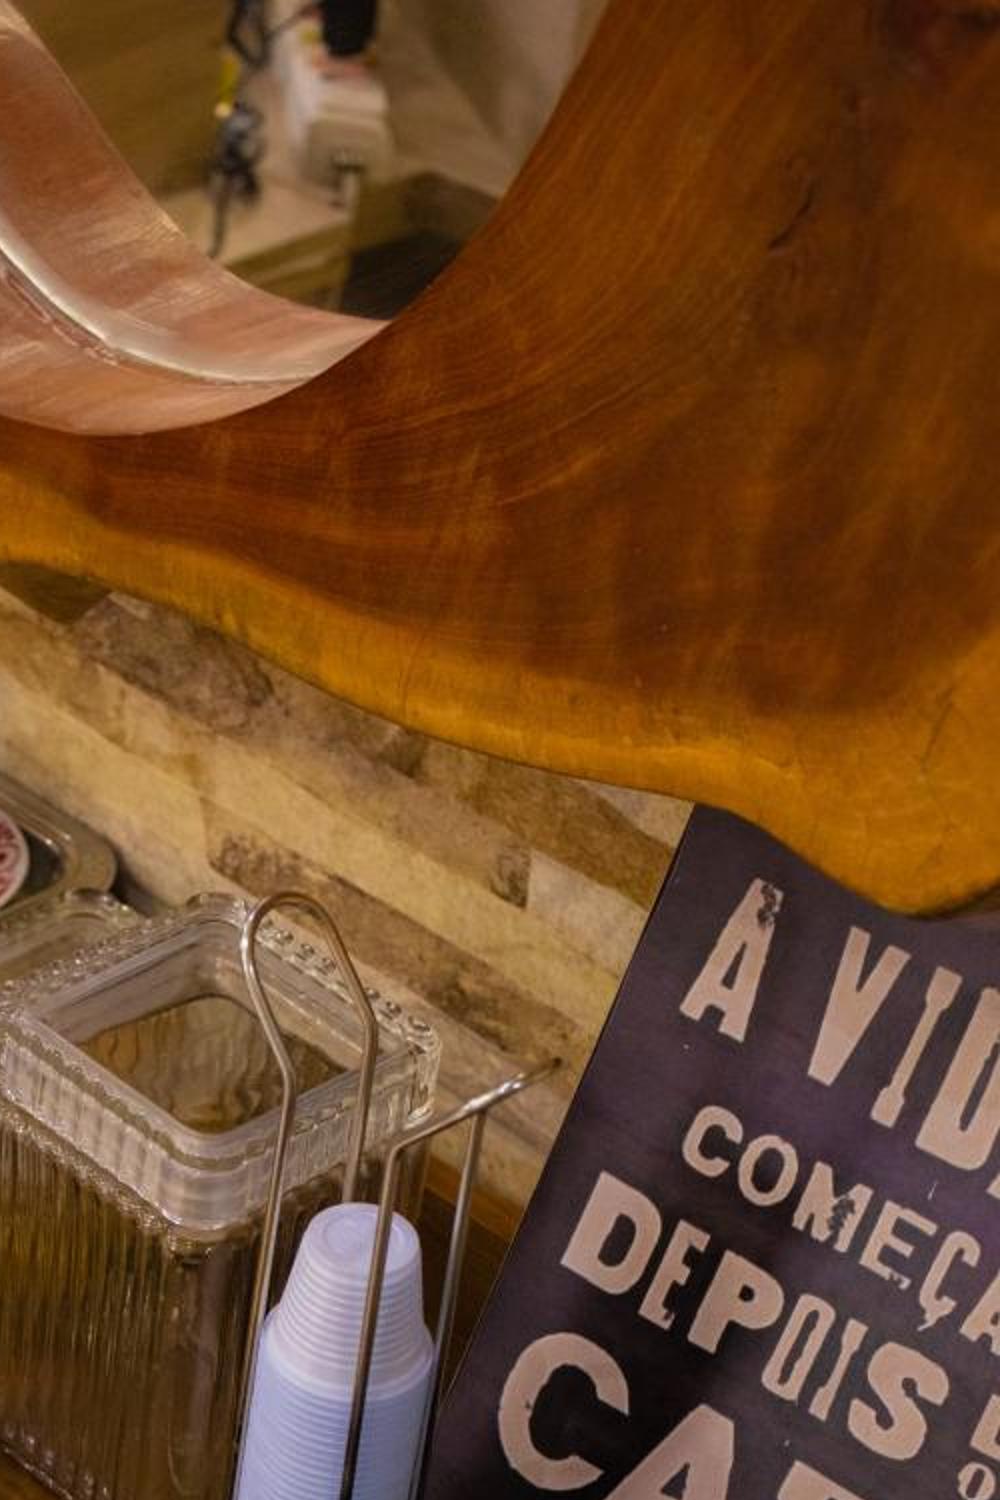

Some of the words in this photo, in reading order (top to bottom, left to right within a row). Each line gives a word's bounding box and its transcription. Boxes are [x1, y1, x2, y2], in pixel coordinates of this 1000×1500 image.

[679, 878, 784, 1043] A
[807, 925, 1000, 1200] VID
[560, 1171, 950, 1461] DEPOIS
[681, 1105, 1000, 1356] COMEÇA
